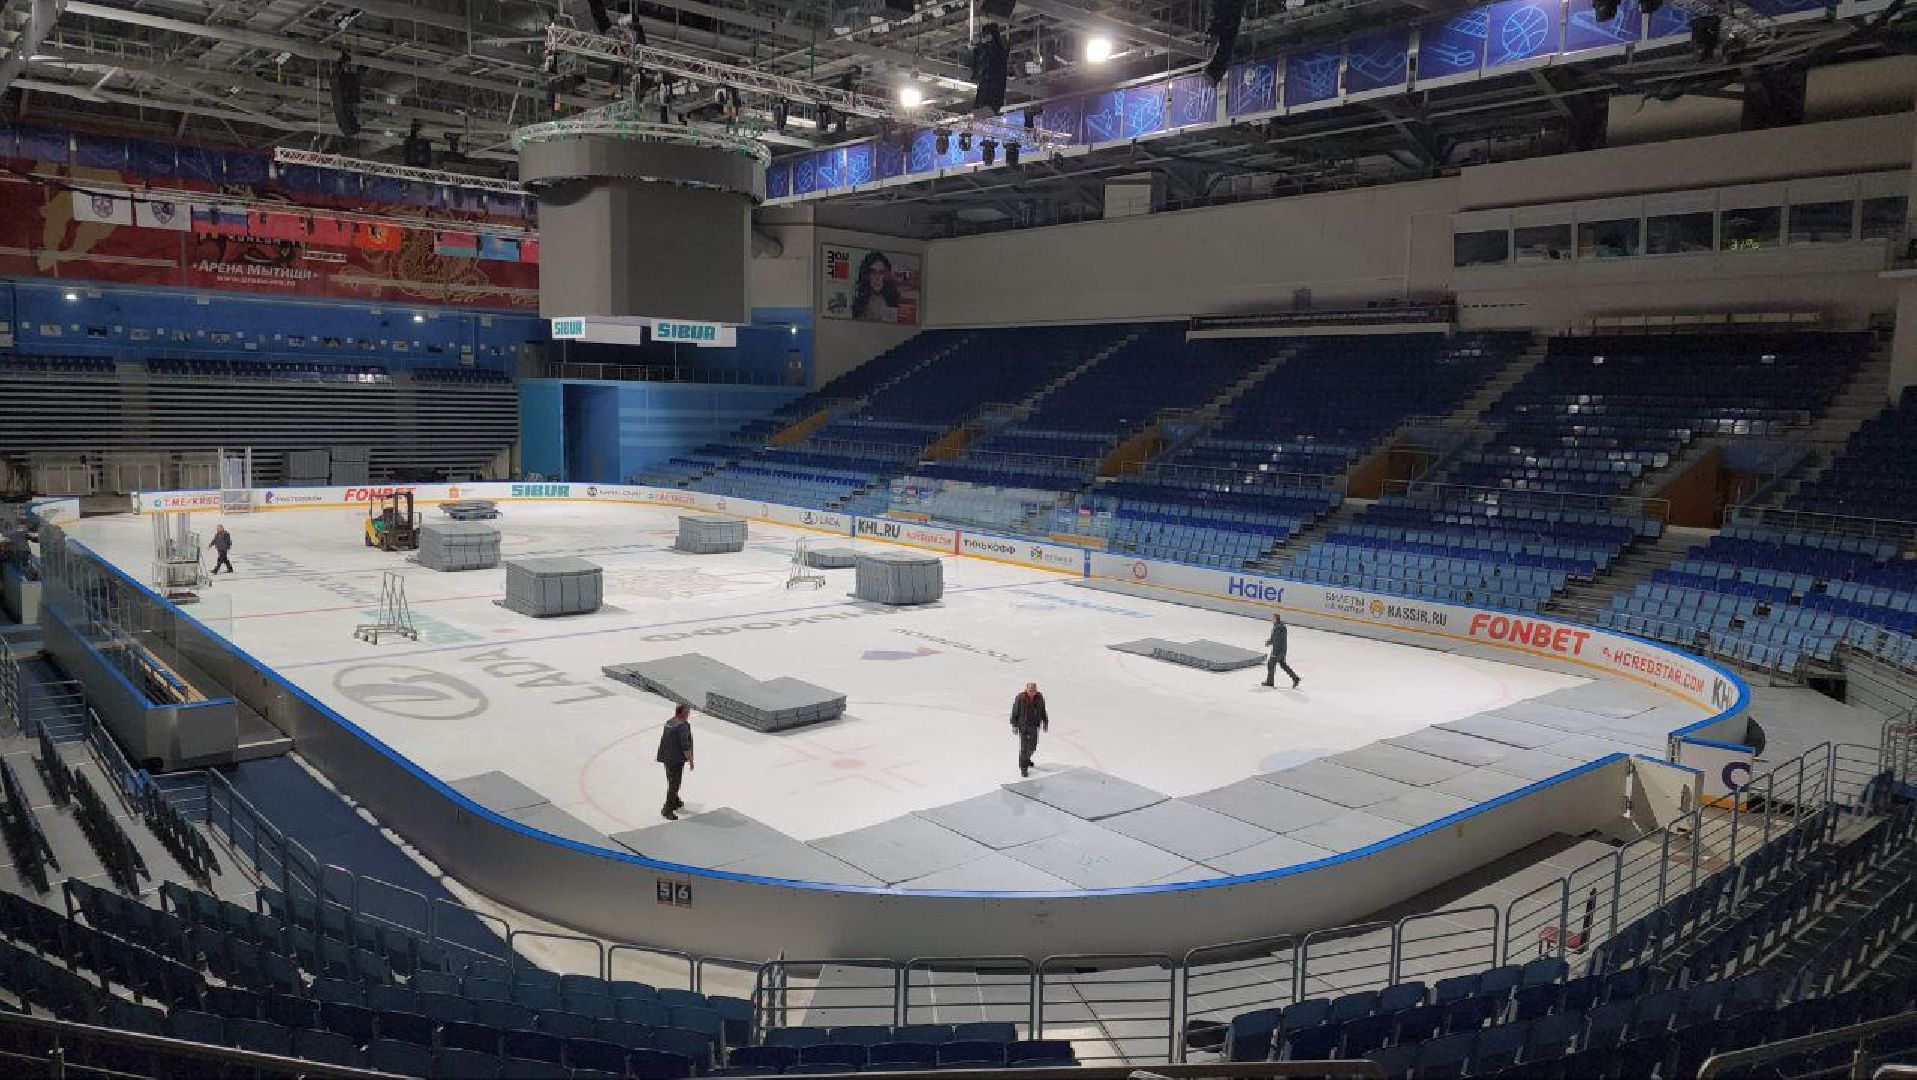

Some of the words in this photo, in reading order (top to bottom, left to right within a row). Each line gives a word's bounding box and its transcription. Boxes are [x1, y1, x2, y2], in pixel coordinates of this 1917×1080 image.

[554, 320, 583, 336] SIBUR
[657, 322, 716, 341] SIBUR
[511, 484, 570, 498] SIBUR
[857, 519, 900, 538] KHL.RU
[1228, 575, 1285, 603] Haier
[1469, 613, 1590, 656] FONBET
